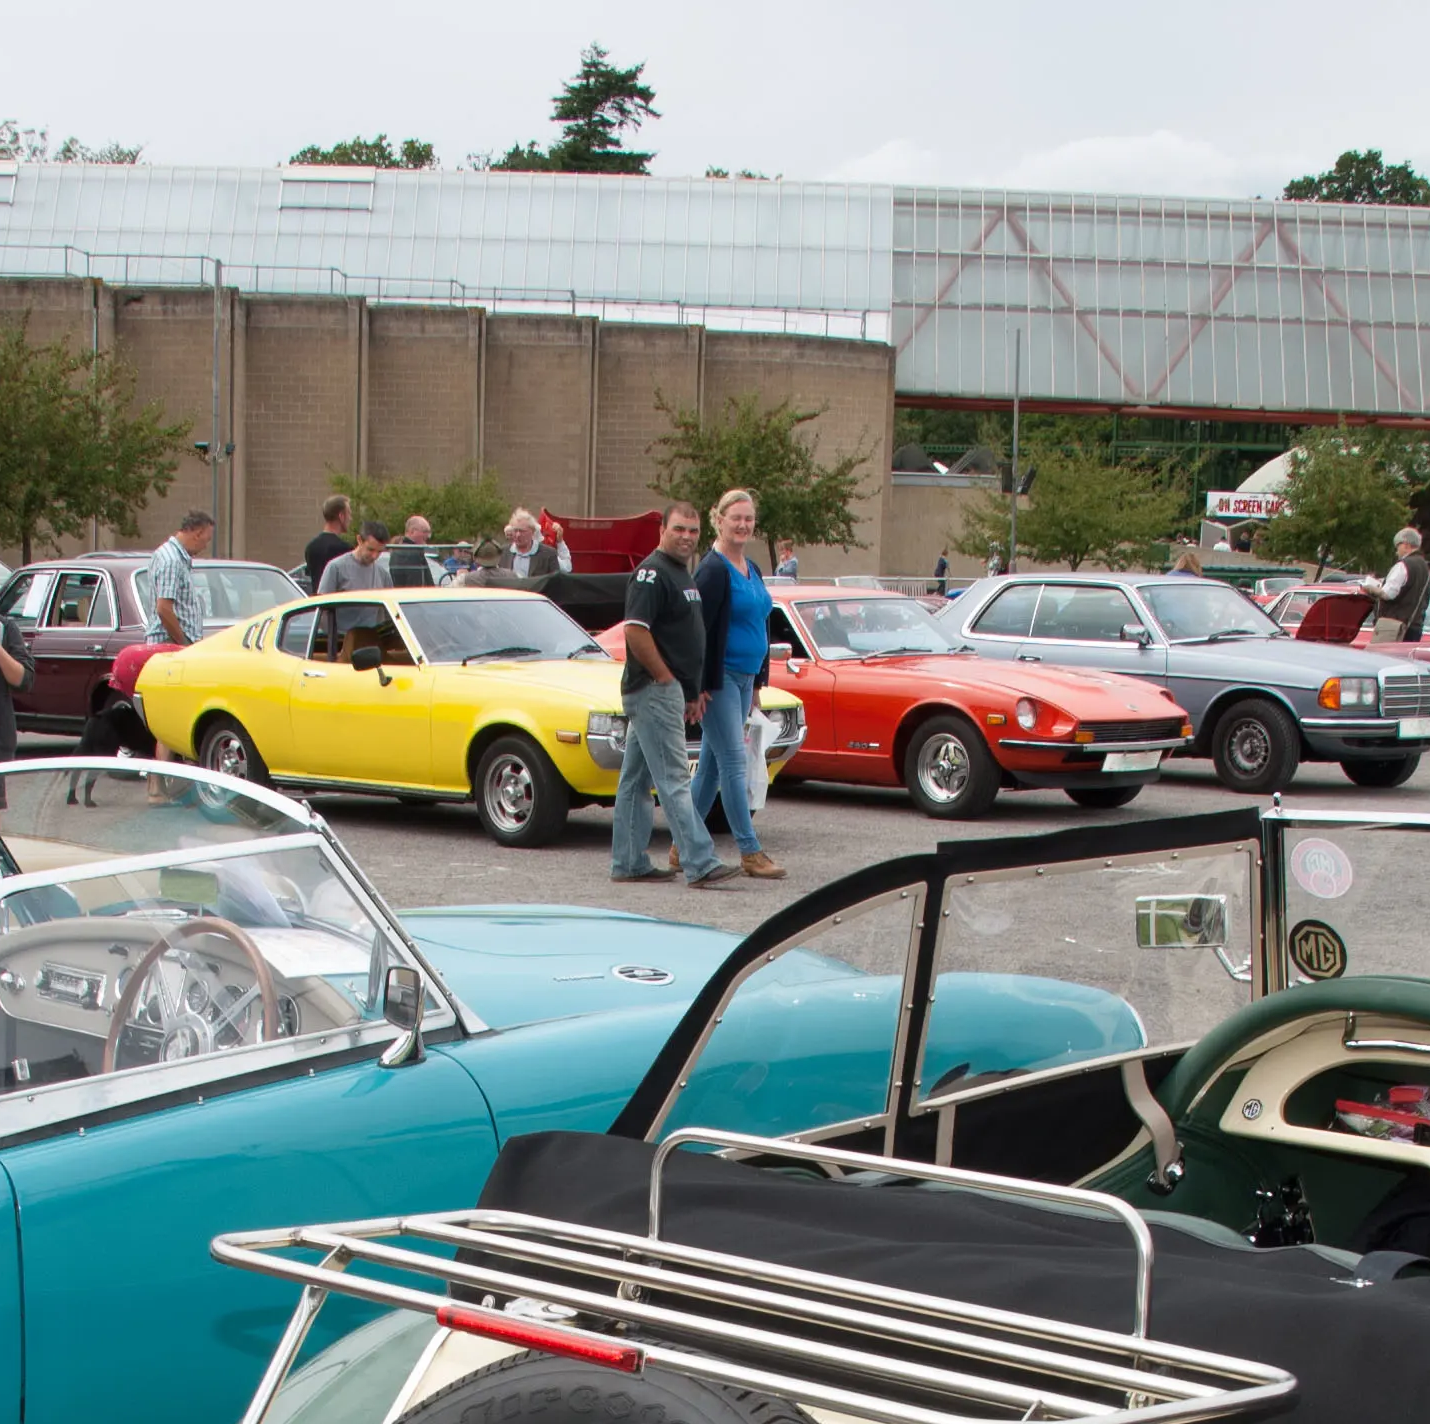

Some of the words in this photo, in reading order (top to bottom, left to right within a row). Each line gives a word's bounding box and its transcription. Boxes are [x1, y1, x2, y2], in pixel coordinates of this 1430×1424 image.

[1233, 499, 1262, 513] SCREEN
[636, 568, 657, 584] 82
[1299, 931, 1336, 972] MG
